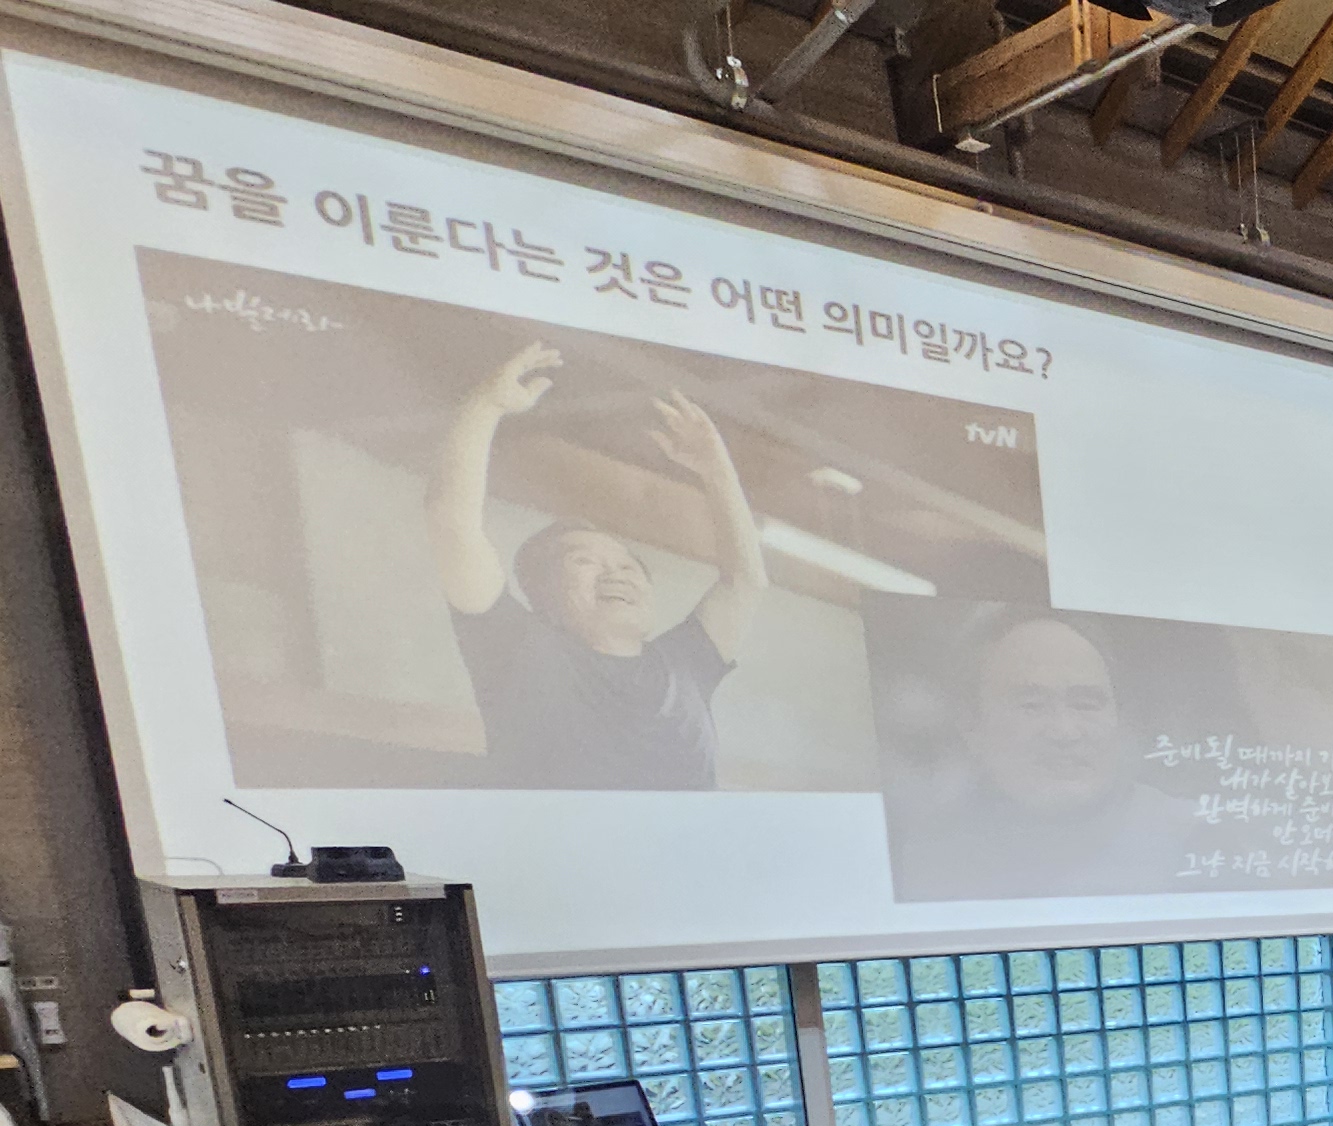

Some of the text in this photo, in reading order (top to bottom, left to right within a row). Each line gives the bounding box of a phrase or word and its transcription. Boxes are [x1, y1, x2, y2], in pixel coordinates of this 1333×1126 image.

[140, 146, 1054, 380] 꿈을 이룬다는 것은 어떤 의미일까요?
[966, 420, 1018, 450] tvN
[1144, 734, 1234, 770] 준비될
[1238, 744, 1311, 765] 때까지
[1220, 769, 1271, 792] 내가
[1193, 794, 1294, 823] 완벽하게
[1176, 849, 1225, 878] 그냥
[1232, 850, 1272, 877] 지금
